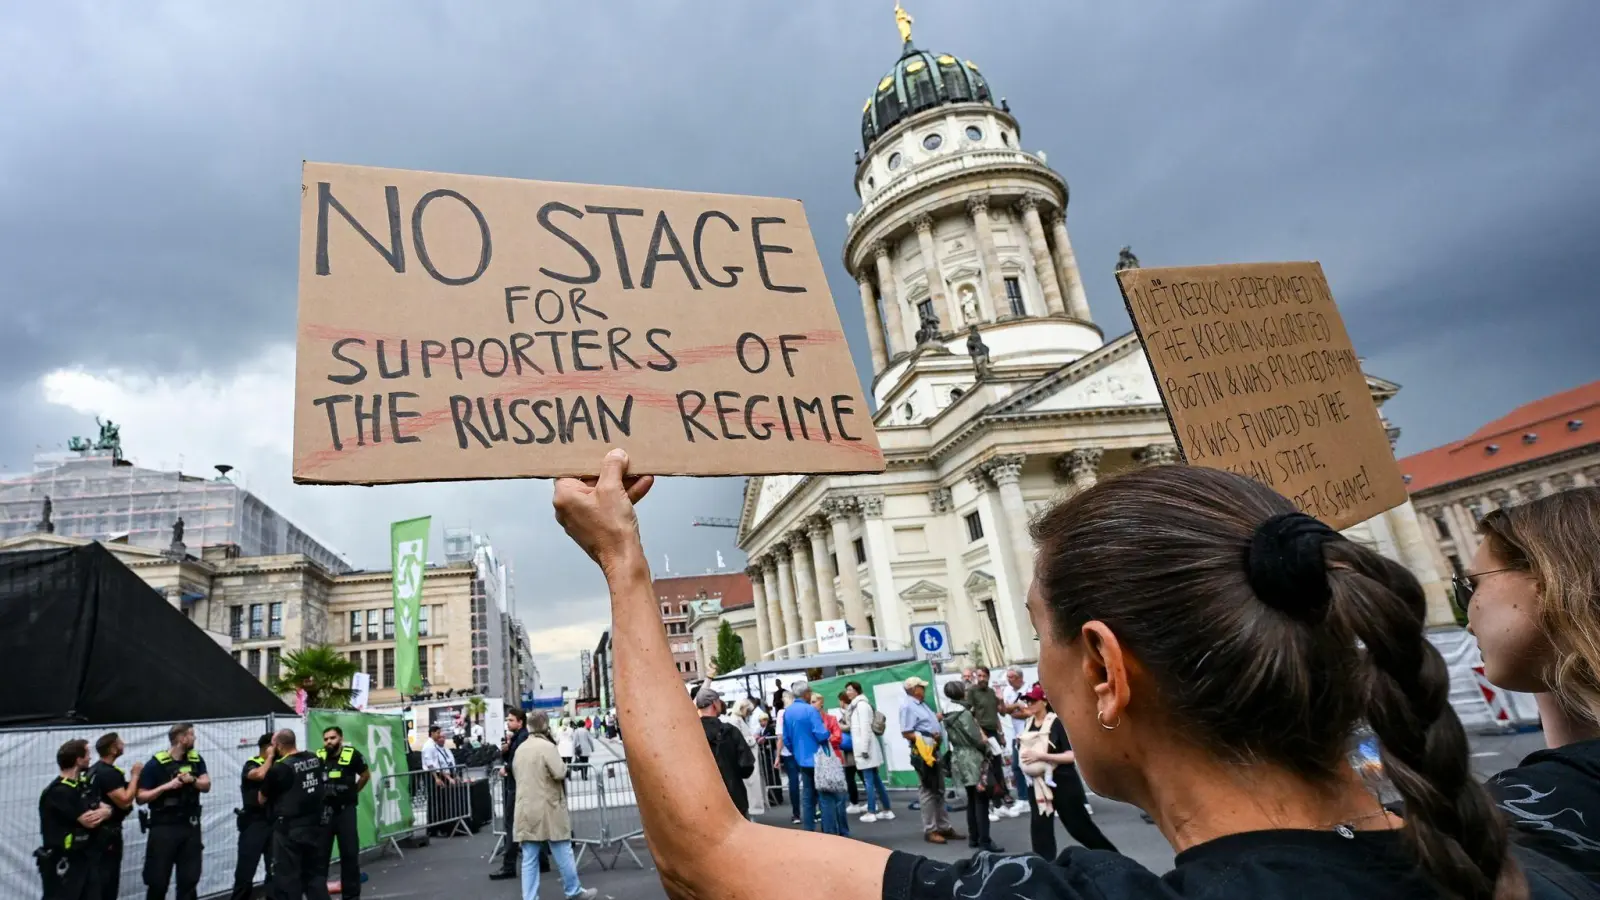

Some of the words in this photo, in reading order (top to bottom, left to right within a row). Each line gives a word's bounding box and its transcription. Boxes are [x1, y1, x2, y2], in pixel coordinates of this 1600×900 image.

[316, 181, 493, 286] NO
[536, 201, 807, 294] STAGE
[504, 286, 608, 325] FOR
[1231, 276, 1312, 309] PERFORMED
[327, 327, 678, 385] SUPPORTERS
[736, 331, 807, 378] OF
[1147, 327, 1193, 368] THE
[1235, 361, 1272, 394] WAS
[1267, 350, 1327, 388] PRAISED
[313, 391, 422, 451] THE
[450, 394, 633, 449] RUSSIAN
[675, 389, 862, 444] REGIME
[1186, 424, 1206, 461] &
[1200, 418, 1241, 457] WAS
[1237, 404, 1300, 450] FUNDED
[1298, 399, 1321, 429] BY
[1317, 390, 1350, 423] THE
[1324, 464, 1376, 516] SHAME!
